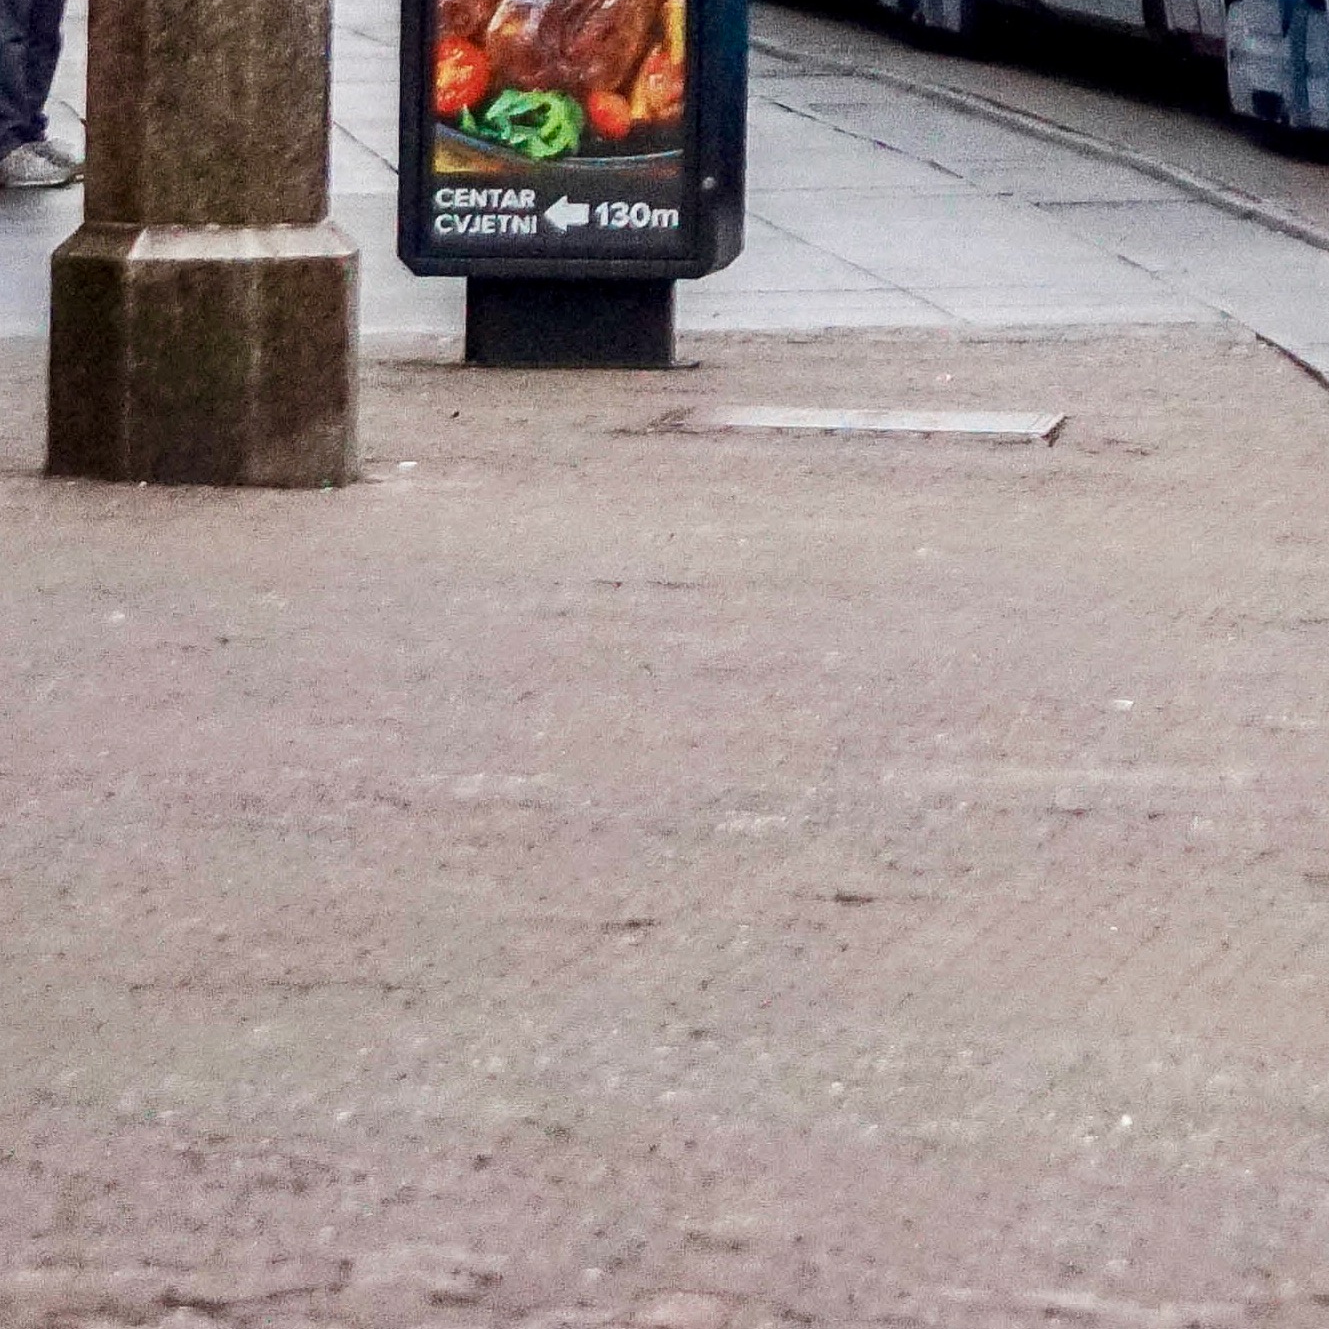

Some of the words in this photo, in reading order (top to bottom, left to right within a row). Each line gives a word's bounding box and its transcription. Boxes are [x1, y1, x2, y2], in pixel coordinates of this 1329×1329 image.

[434, 188, 535, 209] CENTAR
[434, 213, 538, 235] CVJETNI
[595, 201, 680, 229] 130m
